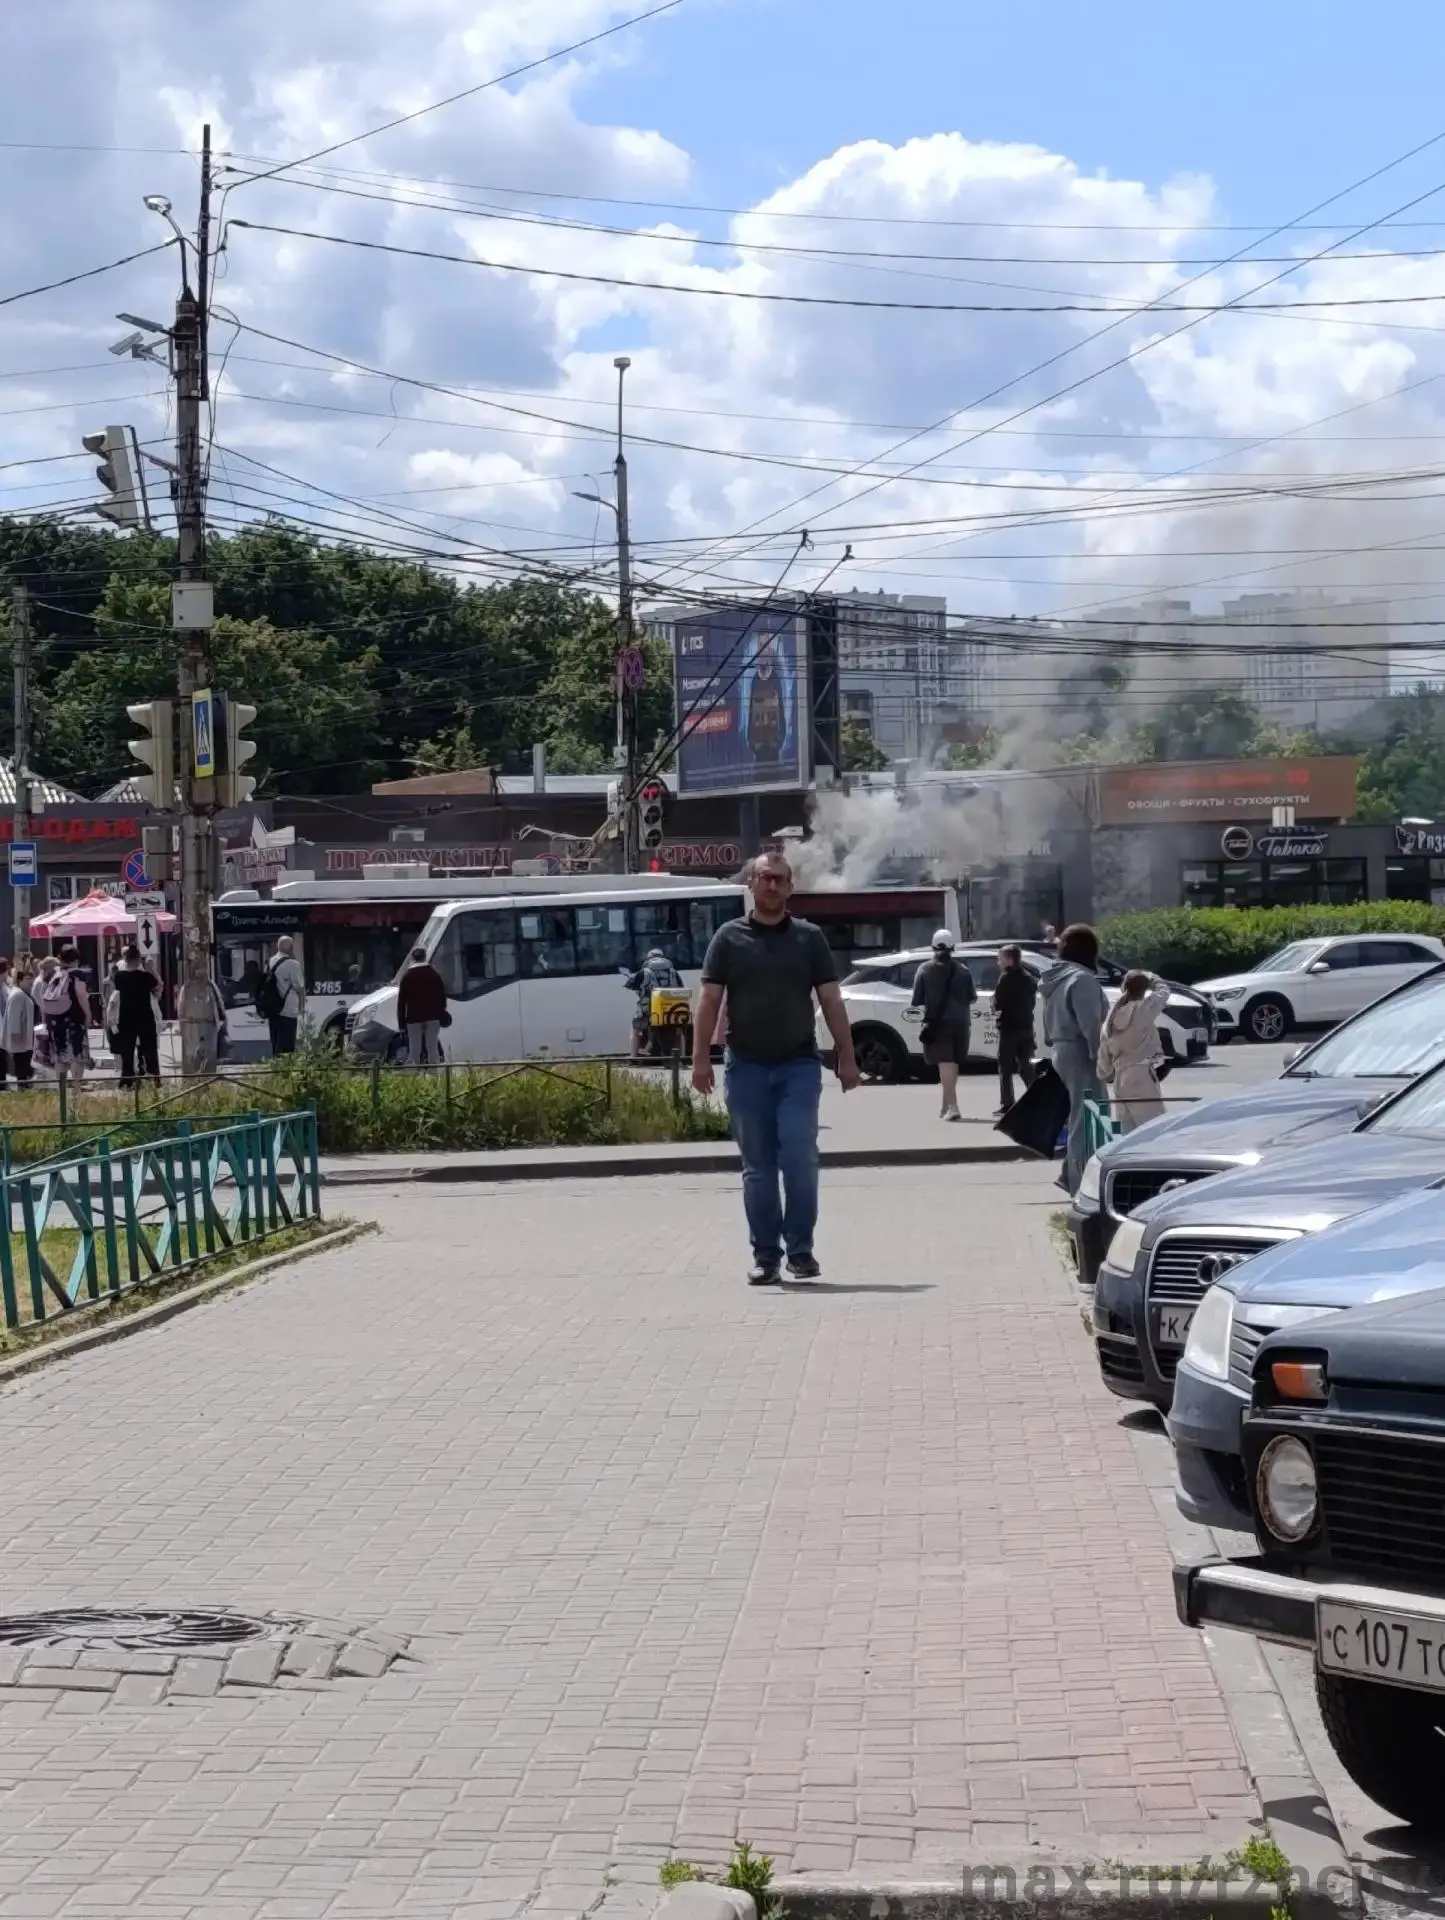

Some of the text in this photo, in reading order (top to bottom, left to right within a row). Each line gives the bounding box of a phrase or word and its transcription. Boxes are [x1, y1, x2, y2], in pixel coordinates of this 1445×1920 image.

[1127, 794, 1311, 810] ОВОЩИ ФРУКТЫ СУХОФРУКТЫ
[1417, 830, 1445, 853] Ряз
